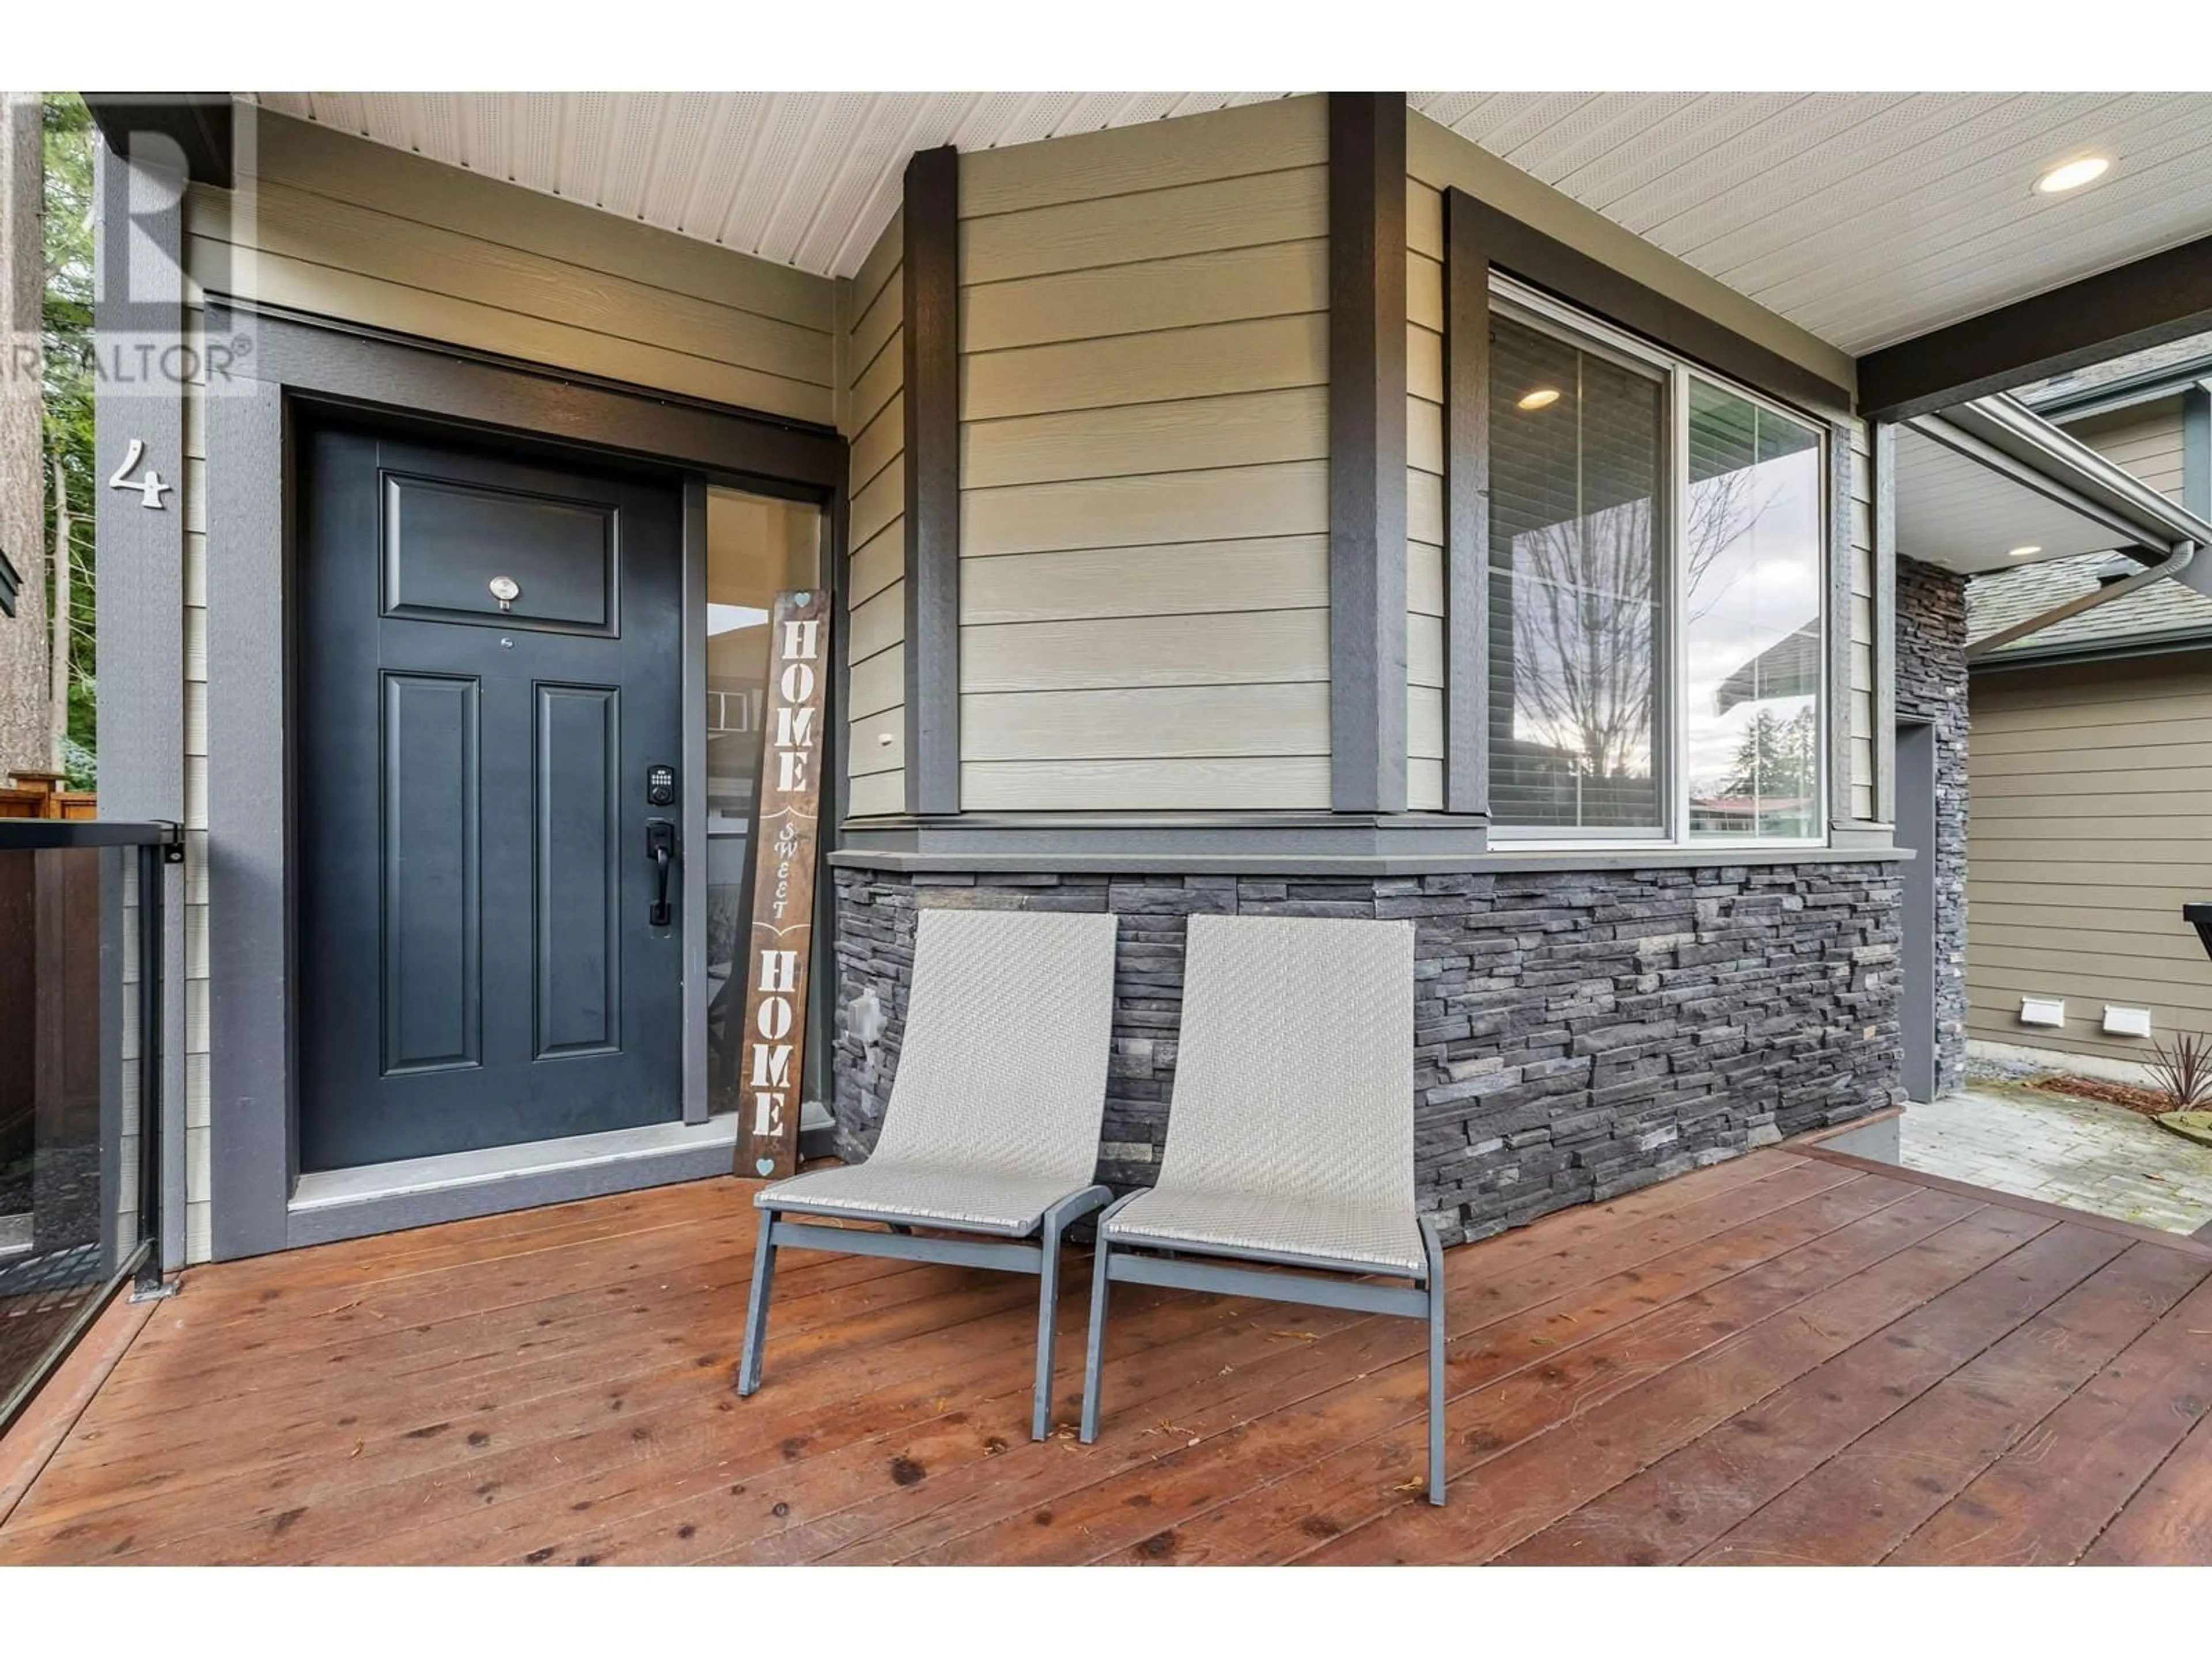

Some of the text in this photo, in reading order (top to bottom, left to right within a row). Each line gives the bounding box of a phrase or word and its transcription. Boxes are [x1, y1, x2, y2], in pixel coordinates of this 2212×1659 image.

[109, 438, 172, 509] 4
[775, 620, 820, 792] HOME
[751, 950, 797, 1136] HOME
